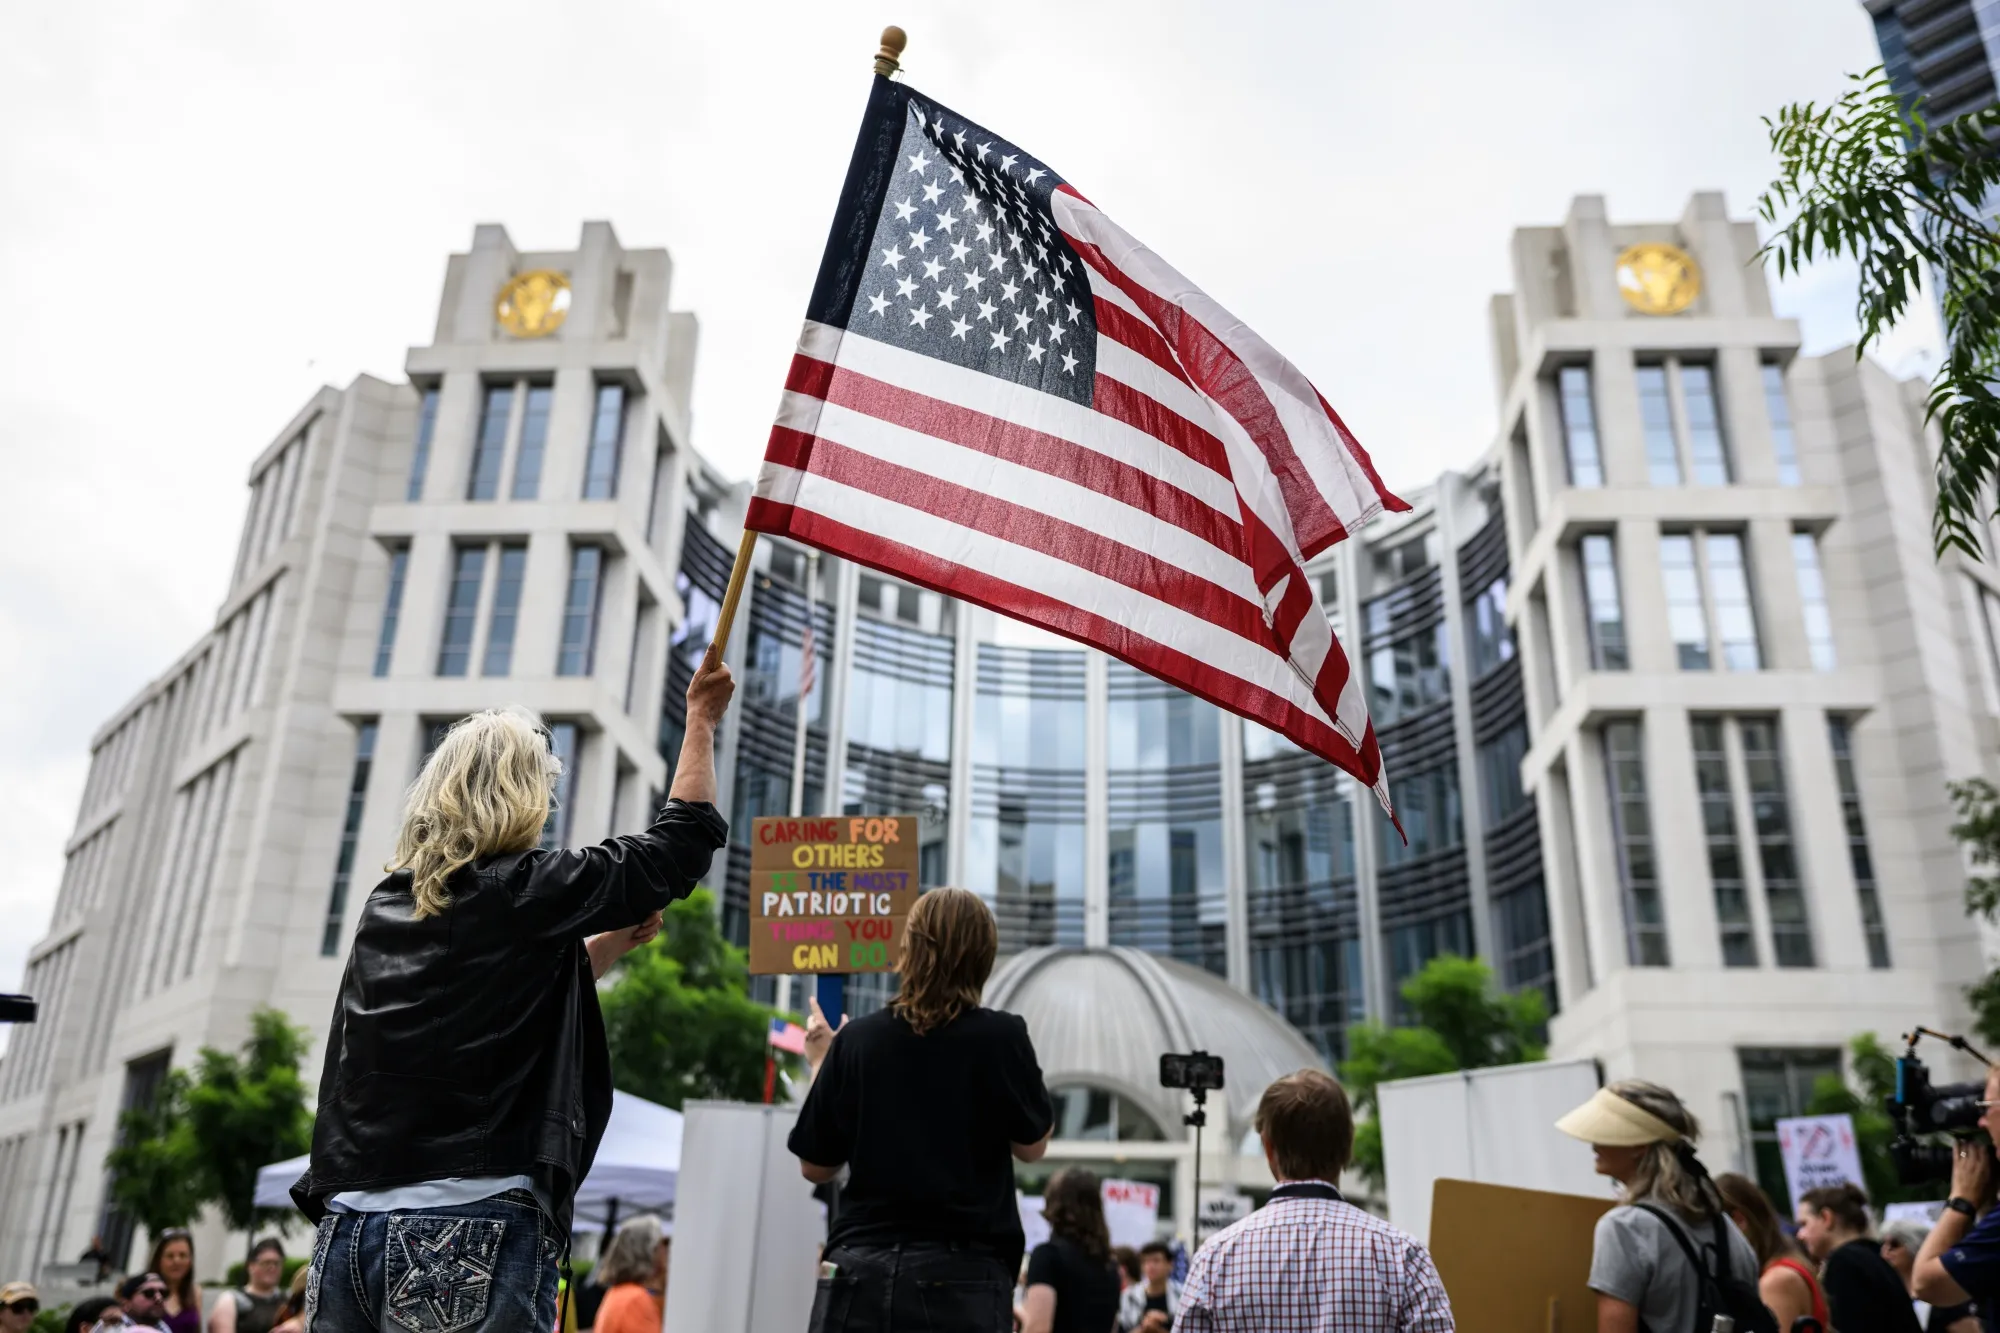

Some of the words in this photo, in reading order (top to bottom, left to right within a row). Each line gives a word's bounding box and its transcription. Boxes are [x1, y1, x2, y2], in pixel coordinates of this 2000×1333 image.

[760, 821, 838, 845] CARING
[849, 818, 900, 843] FOR
[792, 844, 884, 868] OTHERS
[771, 873, 798, 892] IS
[808, 872, 847, 891] THE
[853, 872, 909, 891] MOST
[762, 892, 891, 917] PATRIOTIC
[768, 920, 835, 941] THING
[845, 919, 893, 940] YOU
[792, 943, 838, 969] CAN
